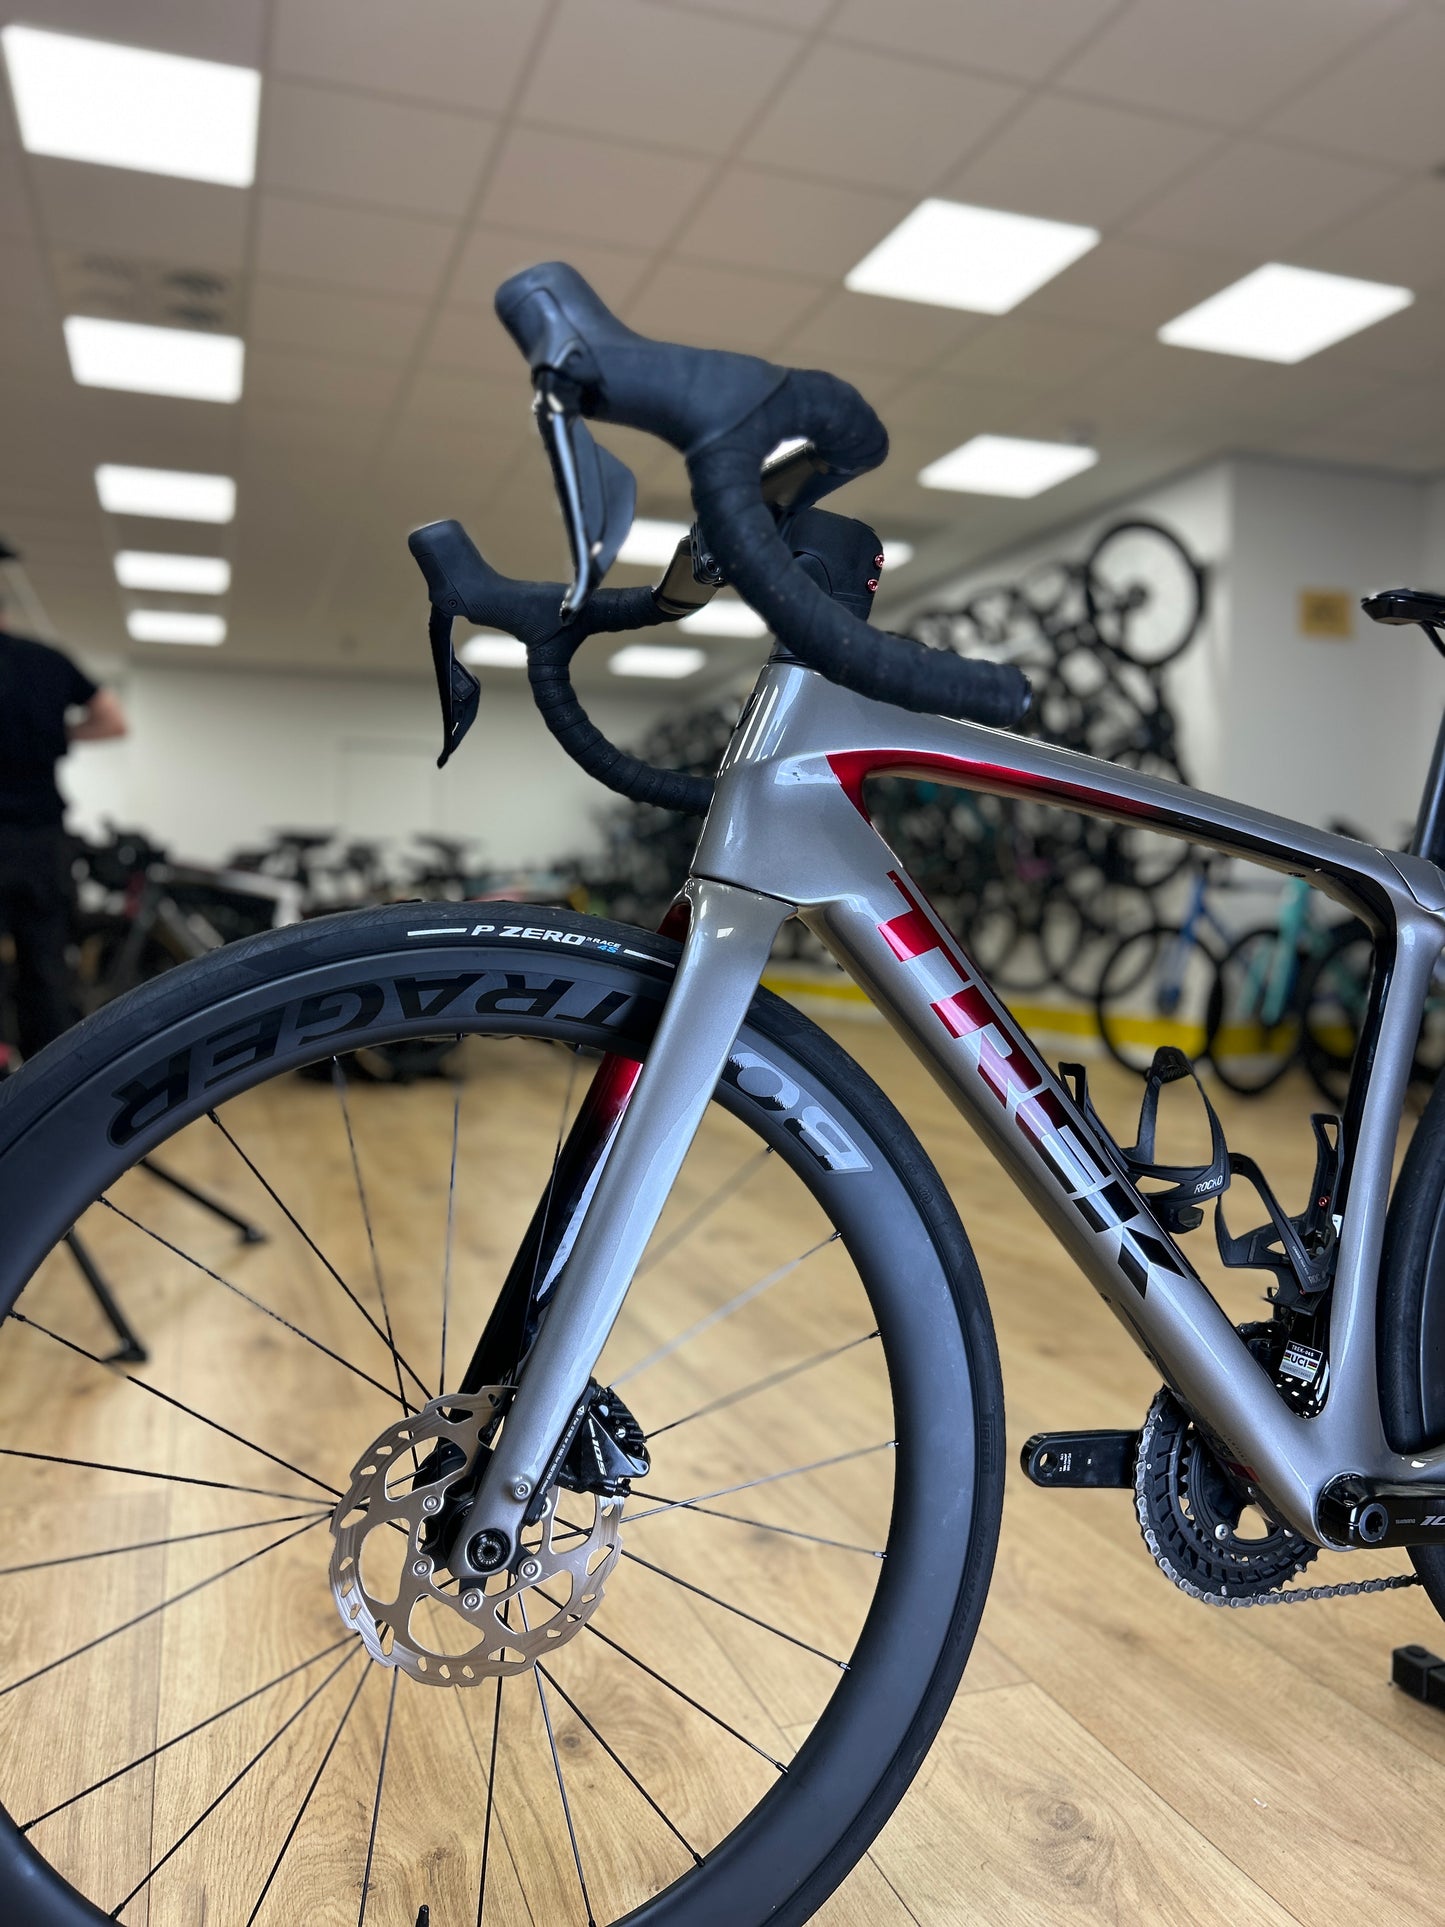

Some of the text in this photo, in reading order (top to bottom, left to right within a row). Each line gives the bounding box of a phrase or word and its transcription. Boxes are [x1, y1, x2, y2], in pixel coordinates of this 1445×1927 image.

[471, 924, 495, 937] P
[877, 870, 1187, 1299] TREK
[1290, 1354, 1308, 1367] UCI
